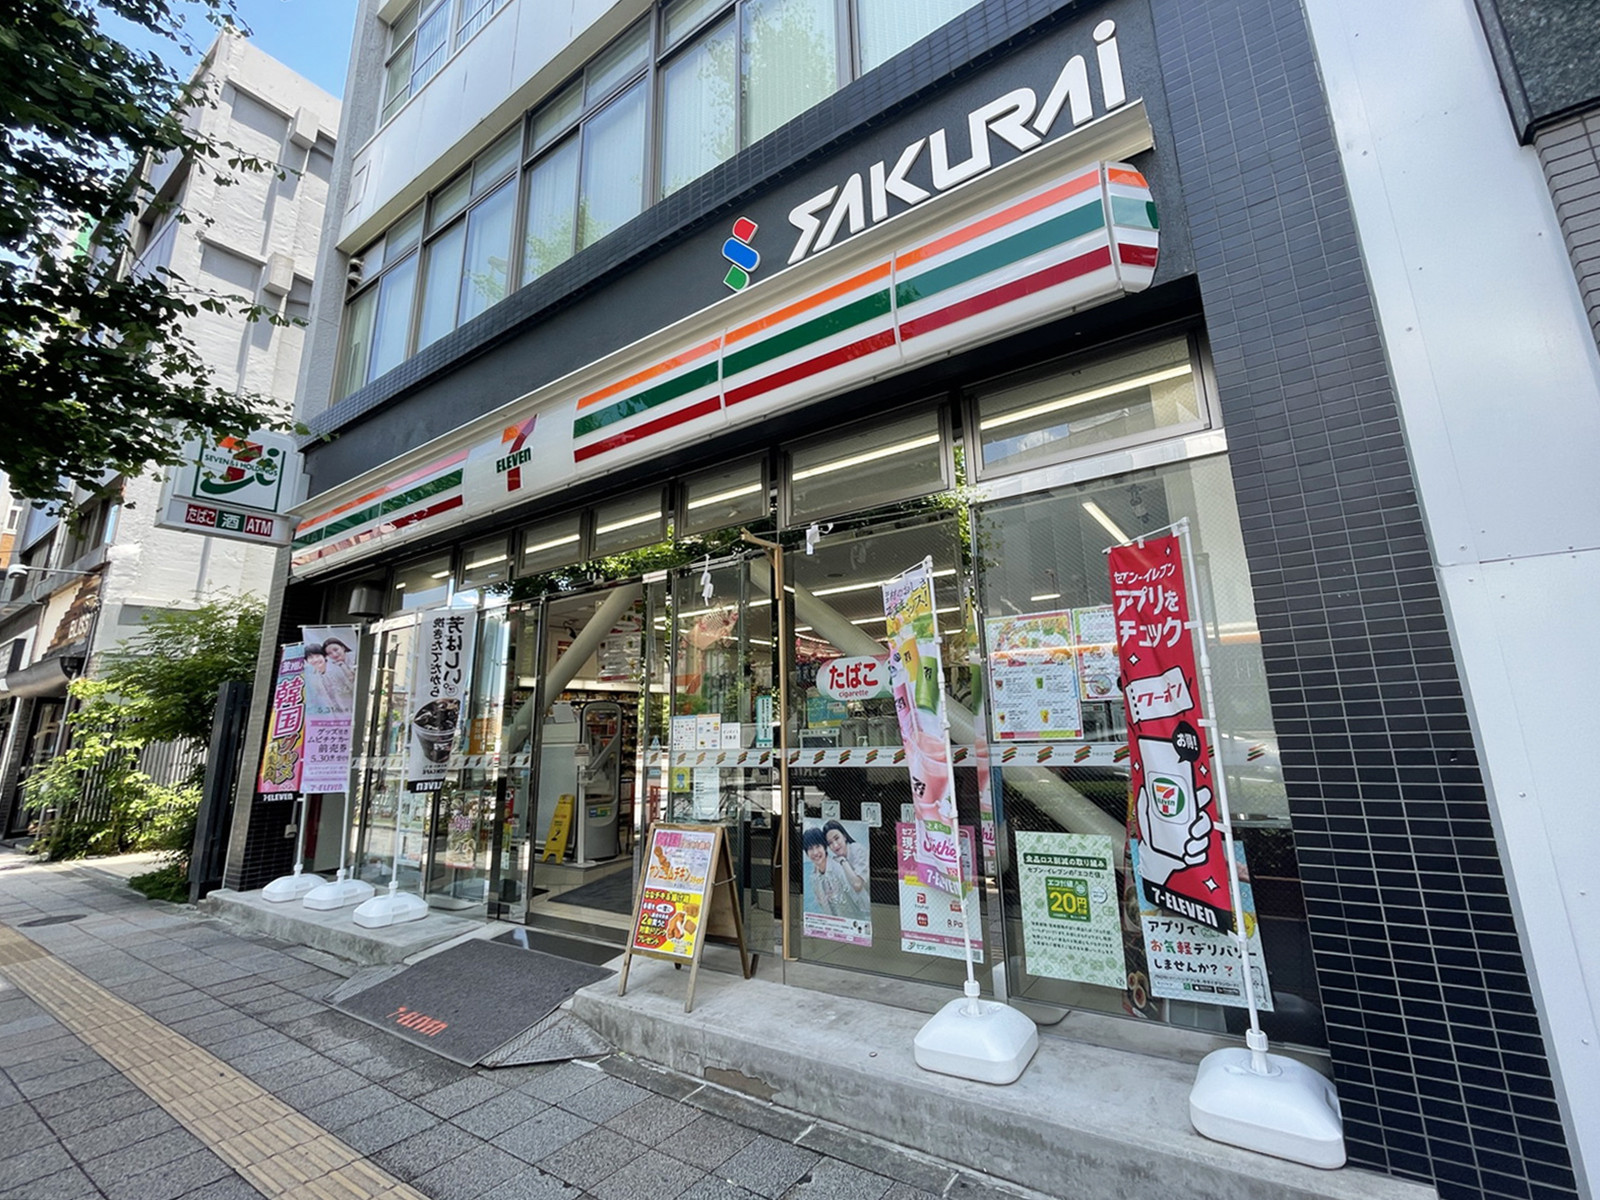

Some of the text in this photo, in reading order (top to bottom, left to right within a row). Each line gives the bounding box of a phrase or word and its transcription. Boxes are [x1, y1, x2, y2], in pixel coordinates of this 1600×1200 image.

[187, 507, 272, 535] たばこ 酒 ATM
[1115, 585, 1180, 616] アプリを
[829, 662, 879, 690] たばこ
[838, 689, 870, 699] cigarette
[1148, 921, 1199, 936] アプリで
